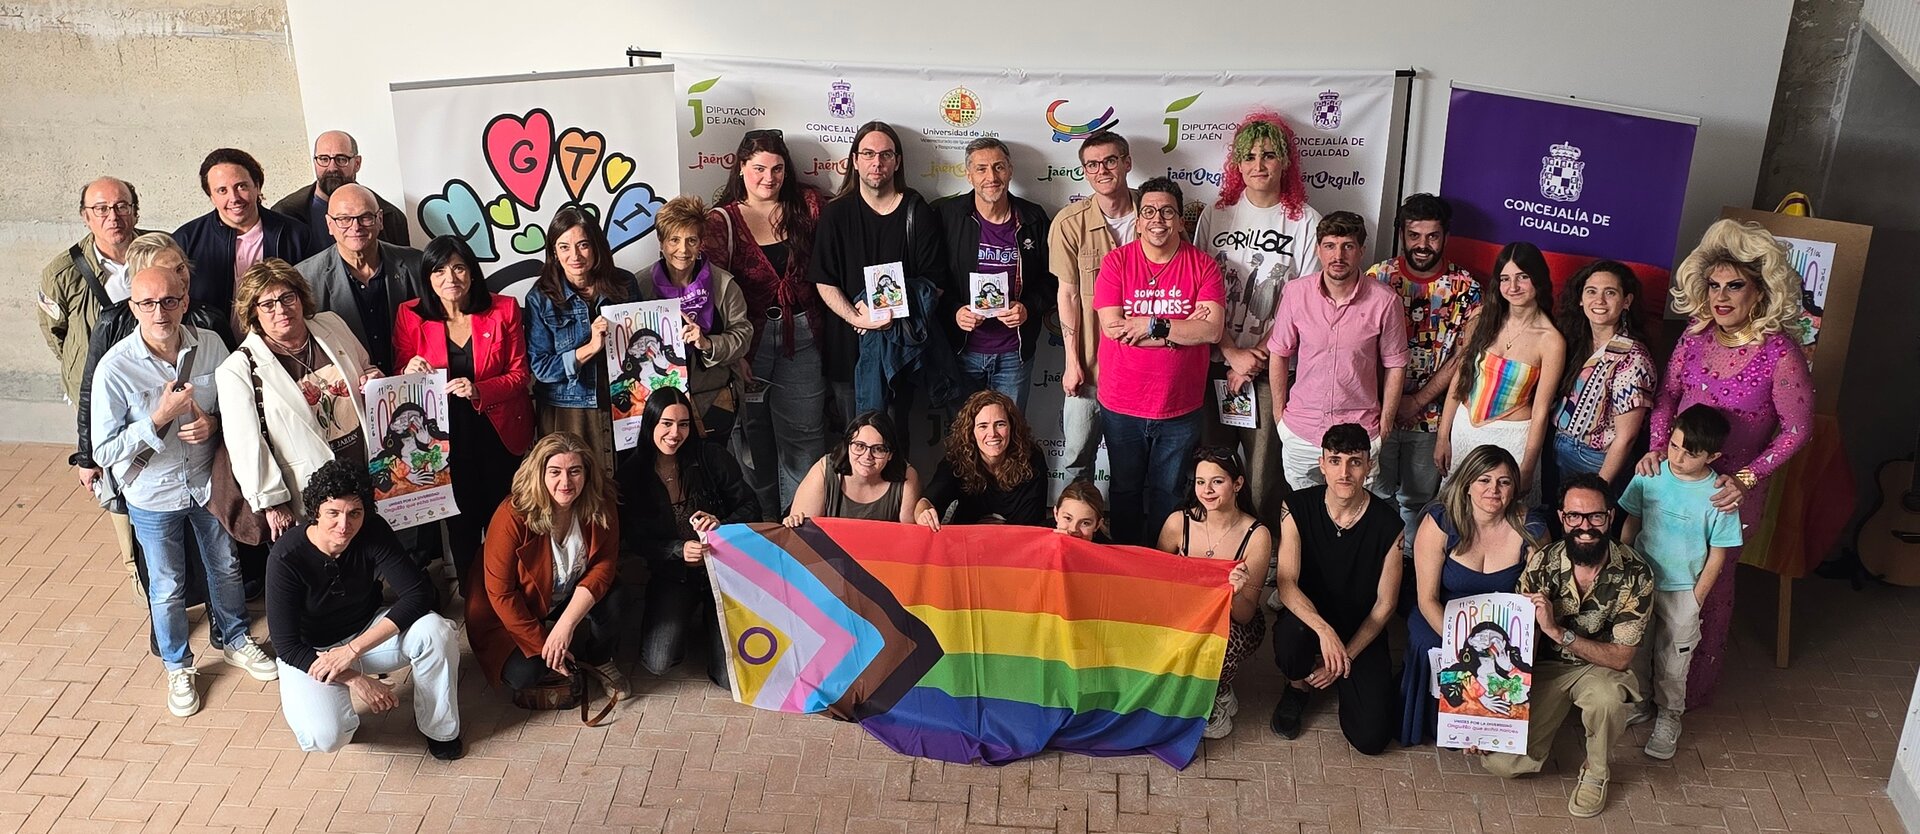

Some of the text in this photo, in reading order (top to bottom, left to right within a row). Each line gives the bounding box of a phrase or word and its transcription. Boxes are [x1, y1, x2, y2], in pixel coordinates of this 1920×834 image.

[706, 106, 766, 116] DIPUTACIÓN
[722, 117, 746, 126] JAÉN
[806, 123, 860, 133] CONCEJALÍ
[922, 128, 968, 136] Universidad
[980, 130, 999, 138] Jaén
[820, 135, 854, 144] IGUALD
[1197, 132, 1222, 140] JAÉN
[1293, 136, 1364, 146] ONCEJALÍA DE
[1300, 148, 1350, 157] GUALDAD
[1504, 198, 1611, 226] CONCEJALÍA DE
[1520, 216, 1590, 238] IGUALDAD
[1134, 285, 1182, 298] somos de
[1133, 299, 1183, 315] COLORES
